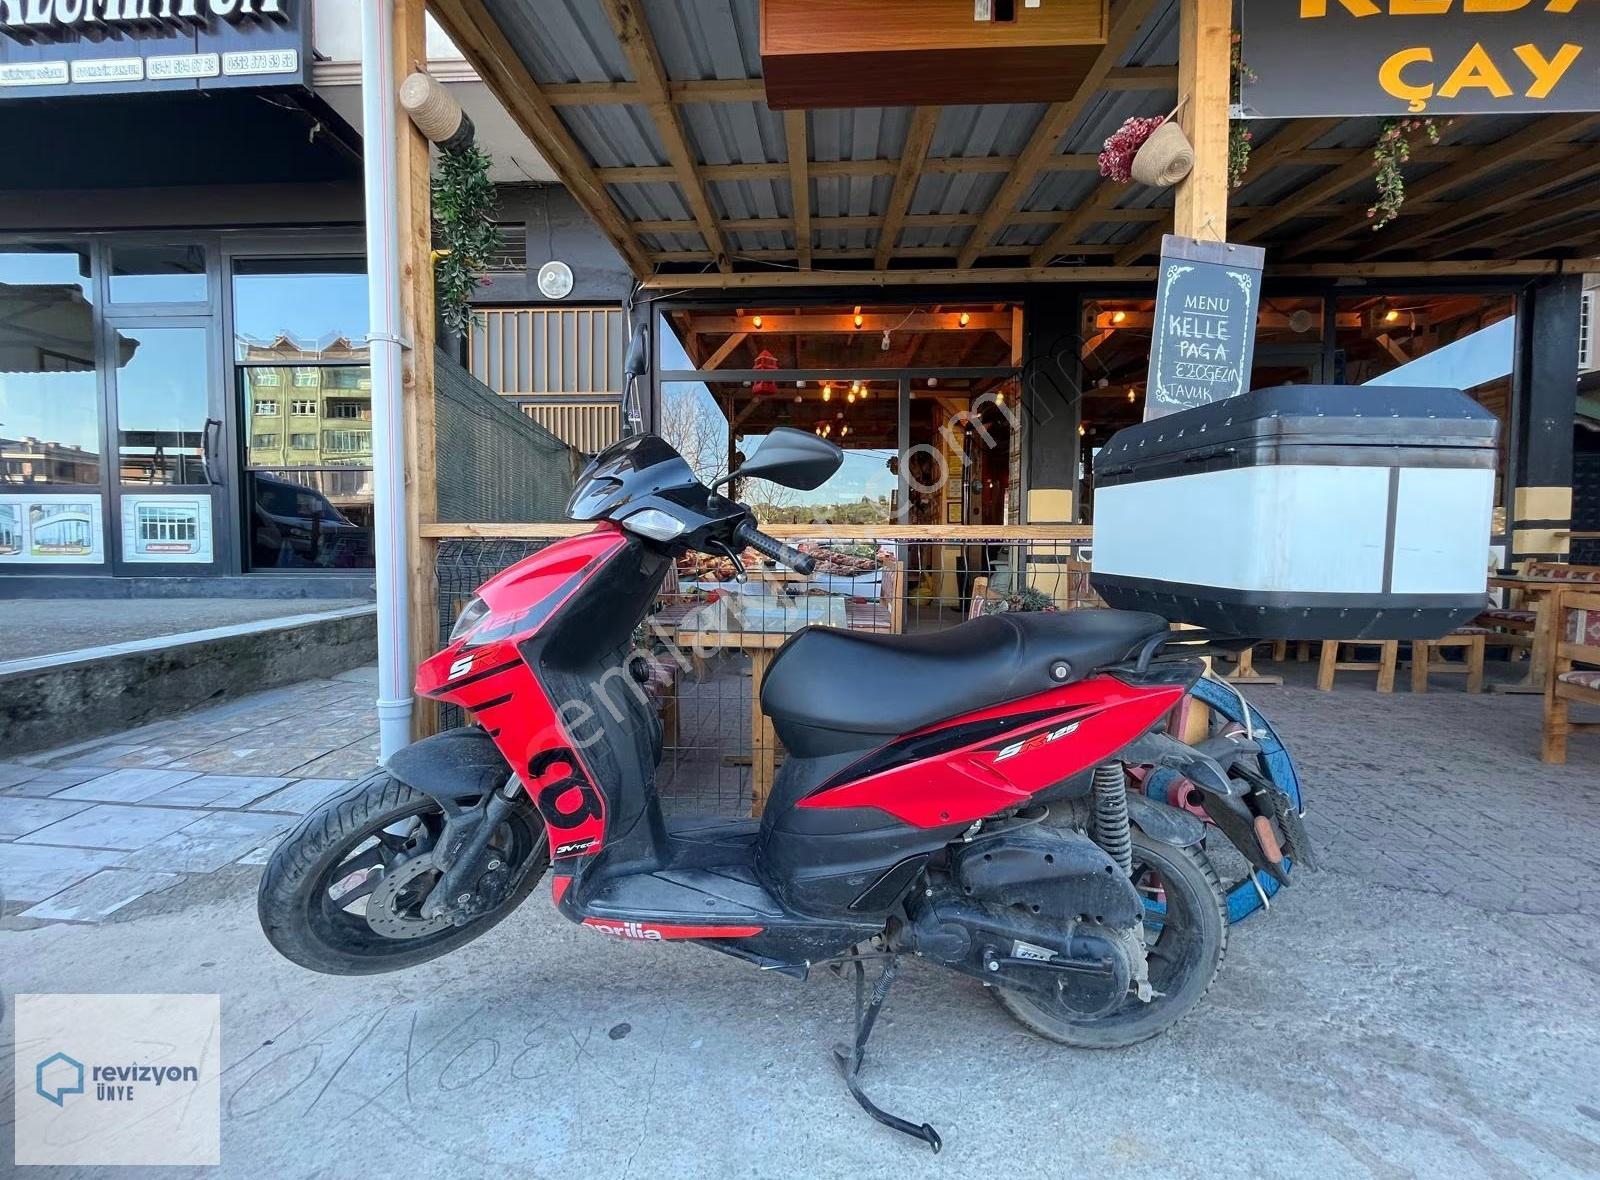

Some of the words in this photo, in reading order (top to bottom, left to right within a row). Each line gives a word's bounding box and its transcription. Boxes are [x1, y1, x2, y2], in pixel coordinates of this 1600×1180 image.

[1379, 42, 1584, 112] ÇAY
[1184, 295, 1230, 312] MENU
[1169, 314, 1229, 340] KELLE
[1168, 383, 1213, 403] TAVUK
